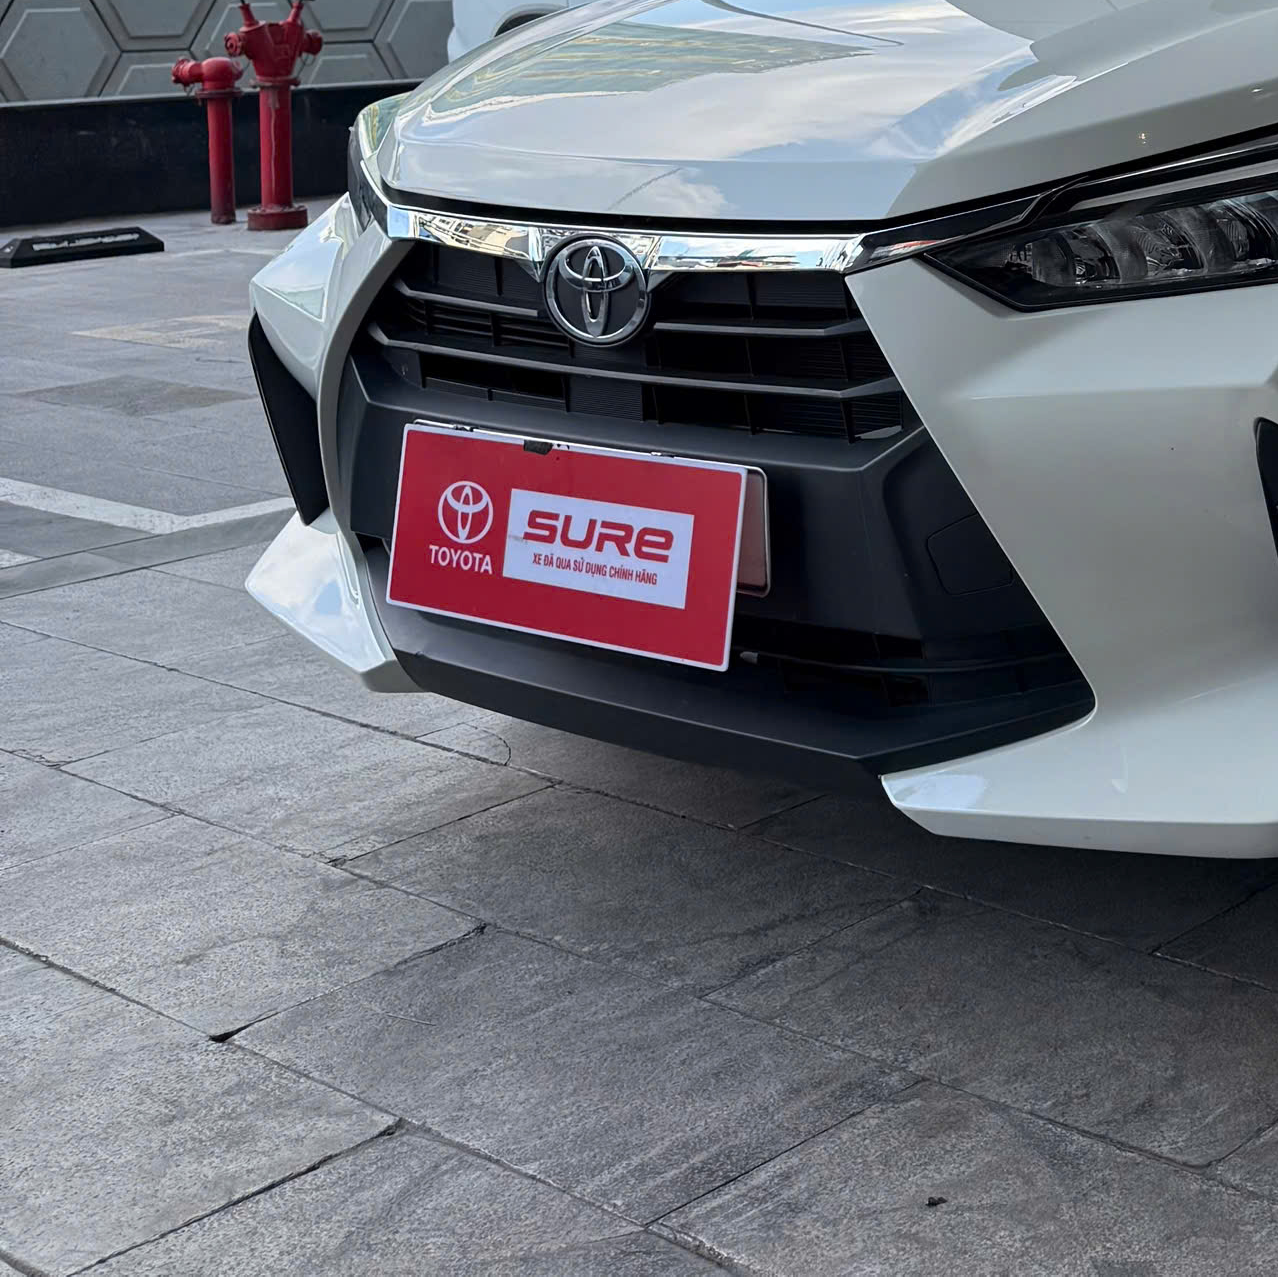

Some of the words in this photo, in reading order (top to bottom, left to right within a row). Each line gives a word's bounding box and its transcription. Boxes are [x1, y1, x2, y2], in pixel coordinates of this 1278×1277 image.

[428, 544, 494, 576] TOYOTA
[532, 552, 543, 566] XE
[543, 553, 554, 568] ĐÃ
[555, 556, 572, 571] QUA
[573, 557, 584, 573] SỬ
[585, 561, 607, 578] DỤNG
[609, 564, 634, 581] CHÍNH
[635, 568, 658, 586] HÃNG
